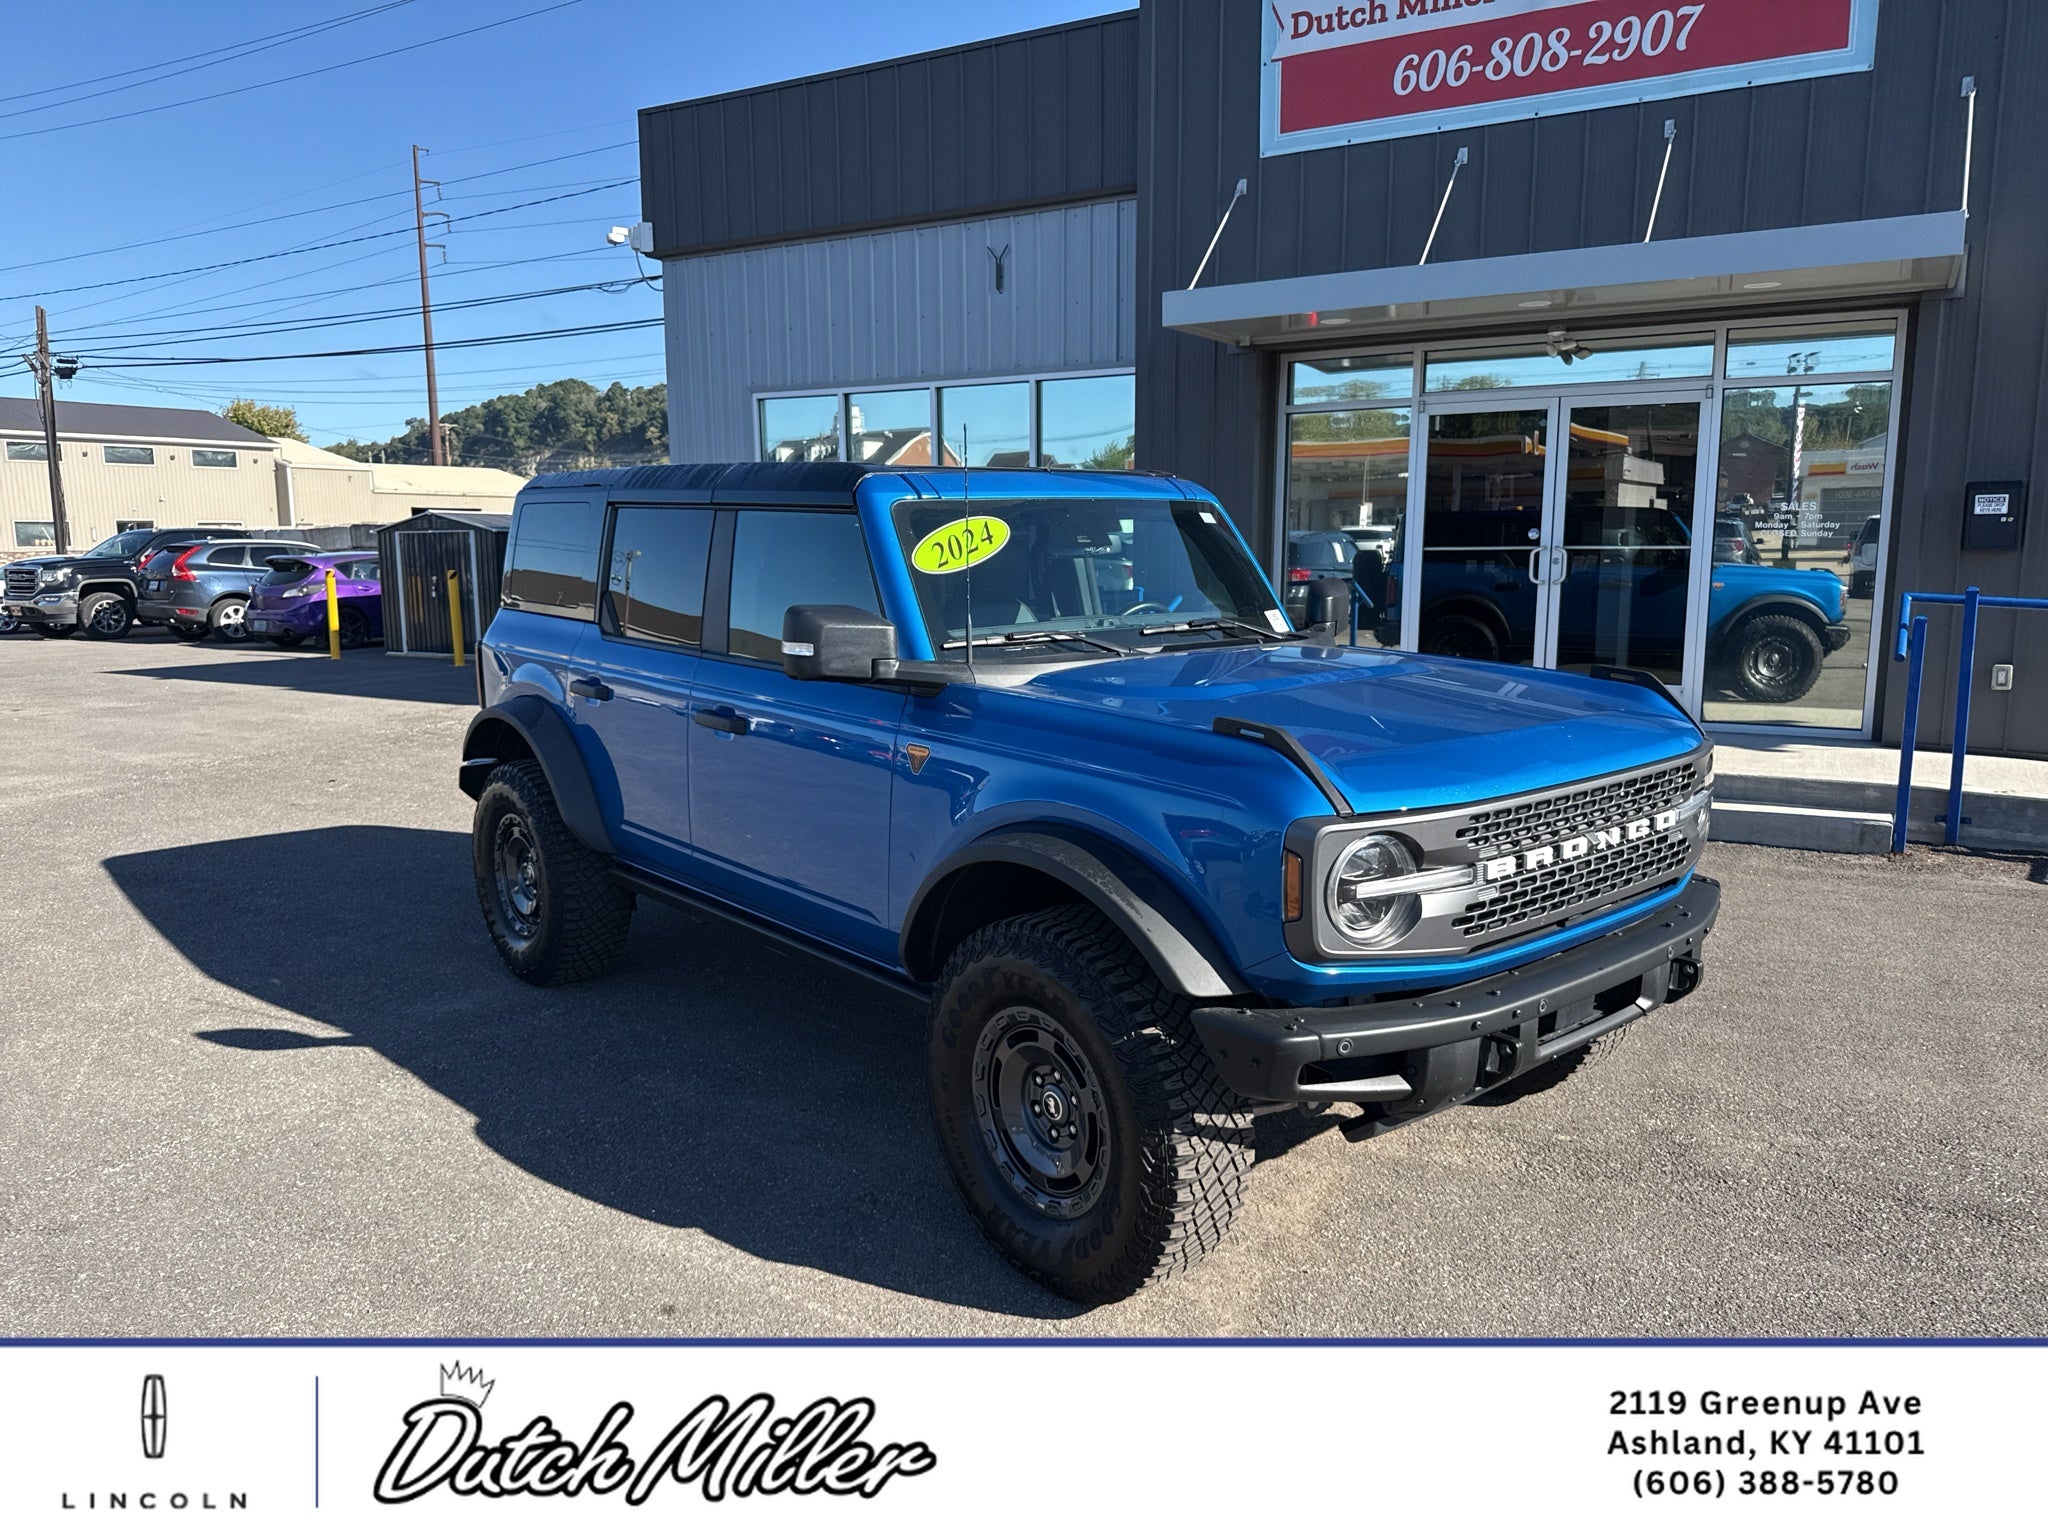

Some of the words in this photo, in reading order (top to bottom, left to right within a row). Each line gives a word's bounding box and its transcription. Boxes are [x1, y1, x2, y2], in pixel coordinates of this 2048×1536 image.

[1290, 0, 1388, 40] Dutch
[1393, 4, 1705, 96] 606-808-2907
[1773, 512, 1793, 520] 9am
[1780, 502, 1817, 511] SALES
[1754, 521, 1789, 529] Monday
[1800, 521, 1840, 529] Saturday
[1800, 530, 1834, 538] Sunday
[931, 521, 993, 568] 2024
[1487, 809, 1678, 881] BRONCO
